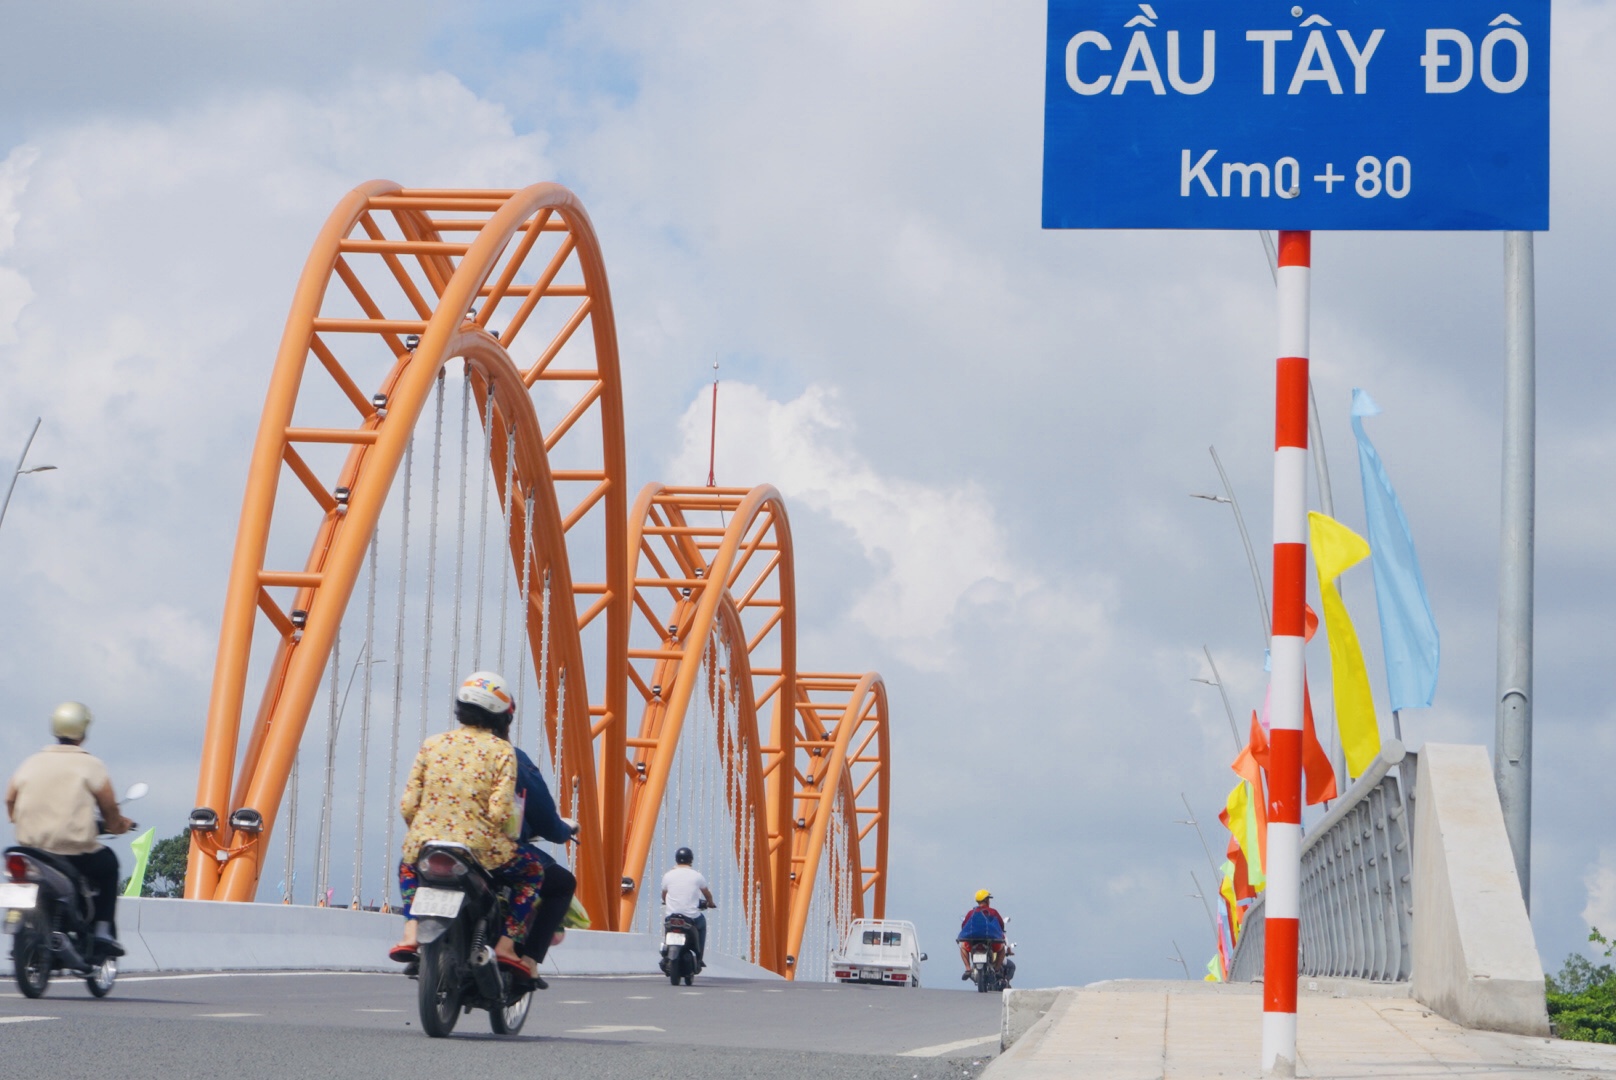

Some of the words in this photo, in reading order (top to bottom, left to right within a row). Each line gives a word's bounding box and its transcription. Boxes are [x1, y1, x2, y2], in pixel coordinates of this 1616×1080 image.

[1066, 4, 1216, 95] CẦU
[1246, 14, 1385, 95] TÂY
[1421, 13, 1529, 94] ĐÔ
